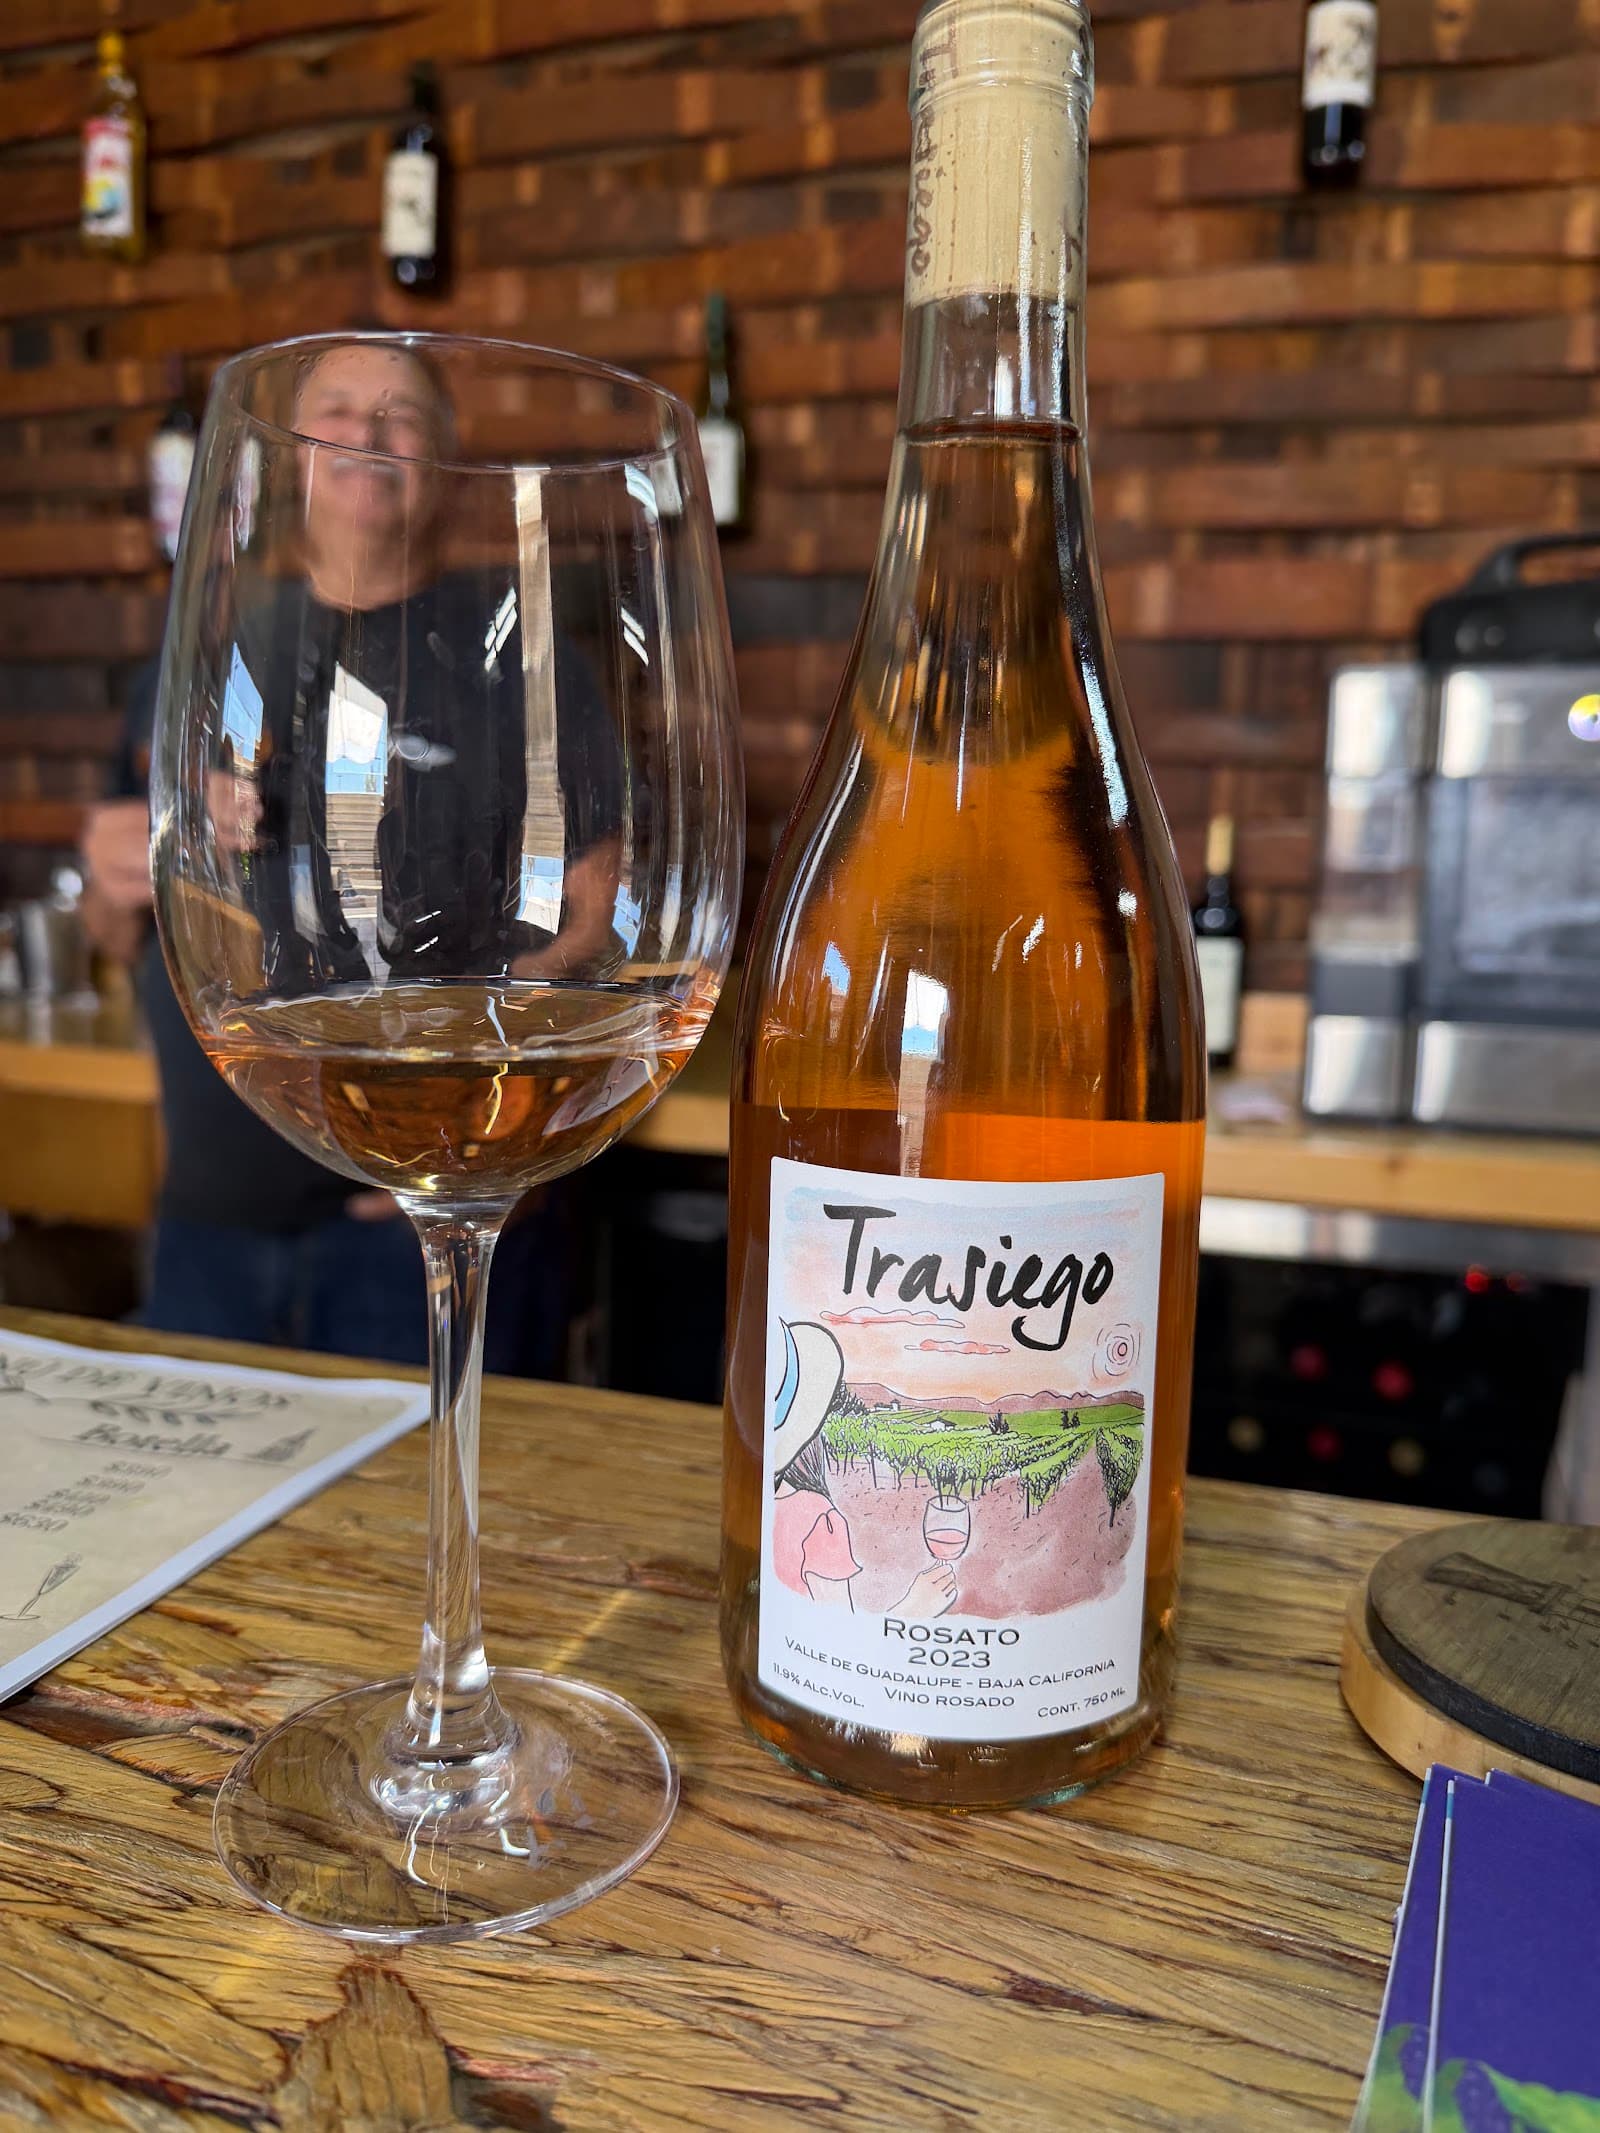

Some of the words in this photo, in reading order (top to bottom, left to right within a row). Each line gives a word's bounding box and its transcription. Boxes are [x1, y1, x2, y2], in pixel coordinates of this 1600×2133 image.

[823, 1203, 1114, 1351] Trasiego
[883, 1617, 1020, 1646] ROSATO
[785, 1635, 828, 1664] VALLE
[831, 1656, 852, 1672] DE
[856, 1663, 962, 1688] GUADALUPE
[978, 1678, 1025, 1689] BAJA
[1029, 1658, 1115, 1687] CALIFORNIA
[908, 1646, 991, 1668] 2023
[884, 1686, 930, 1705] VINO
[935, 1695, 1015, 1708] ROSADO
[1037, 1702, 1081, 1718] CONT.
[1083, 1692, 1109, 1709] 750
[1110, 1686, 1126, 1700] ML
